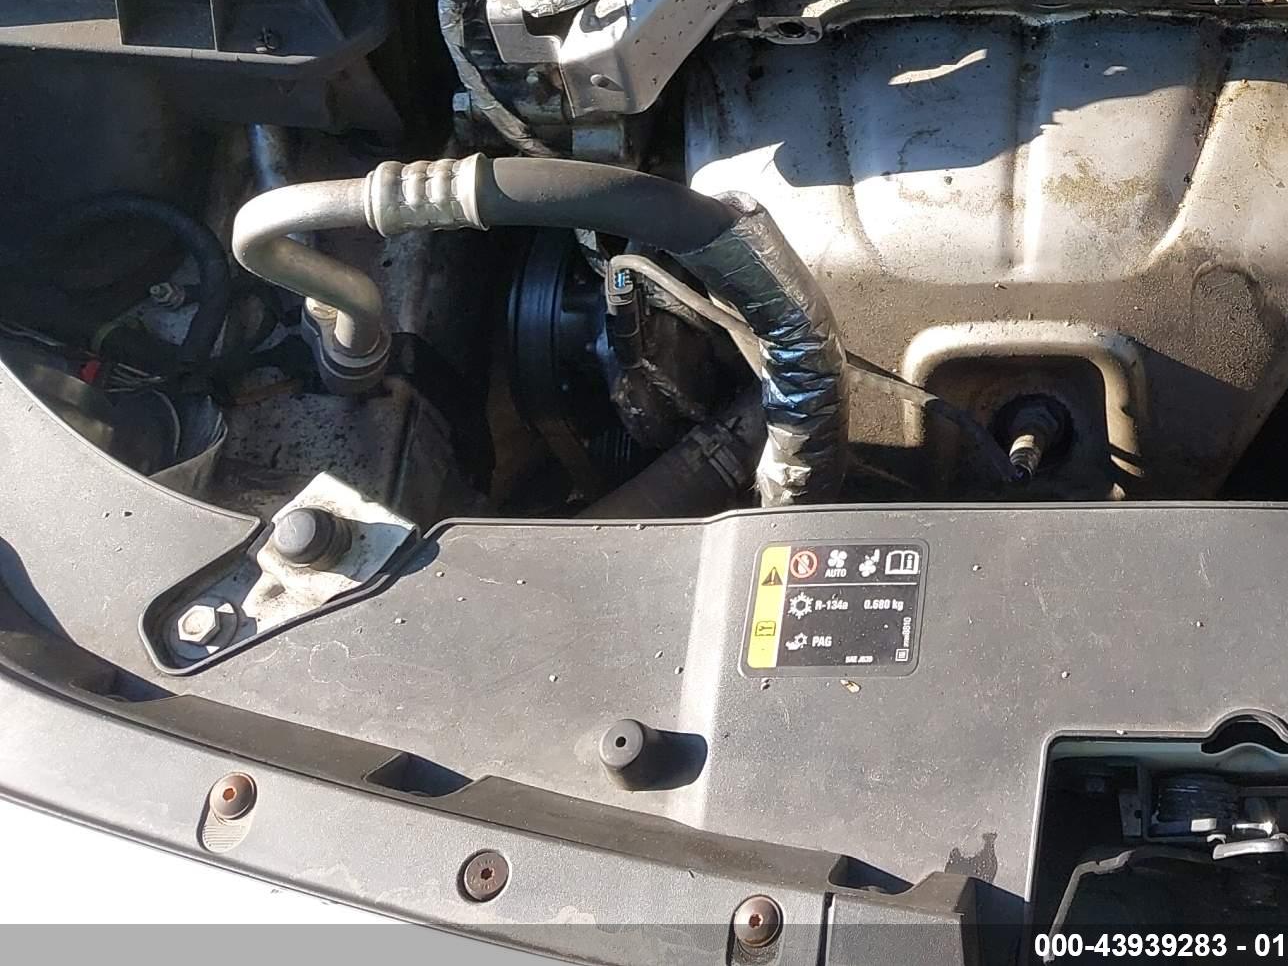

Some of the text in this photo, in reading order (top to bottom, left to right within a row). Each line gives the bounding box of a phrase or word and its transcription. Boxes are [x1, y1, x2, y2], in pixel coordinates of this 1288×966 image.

[825, 569, 847, 578] AUTO
[815, 599, 904, 611] R-134a 0.680 kg
[812, 636, 832, 647] PAG
